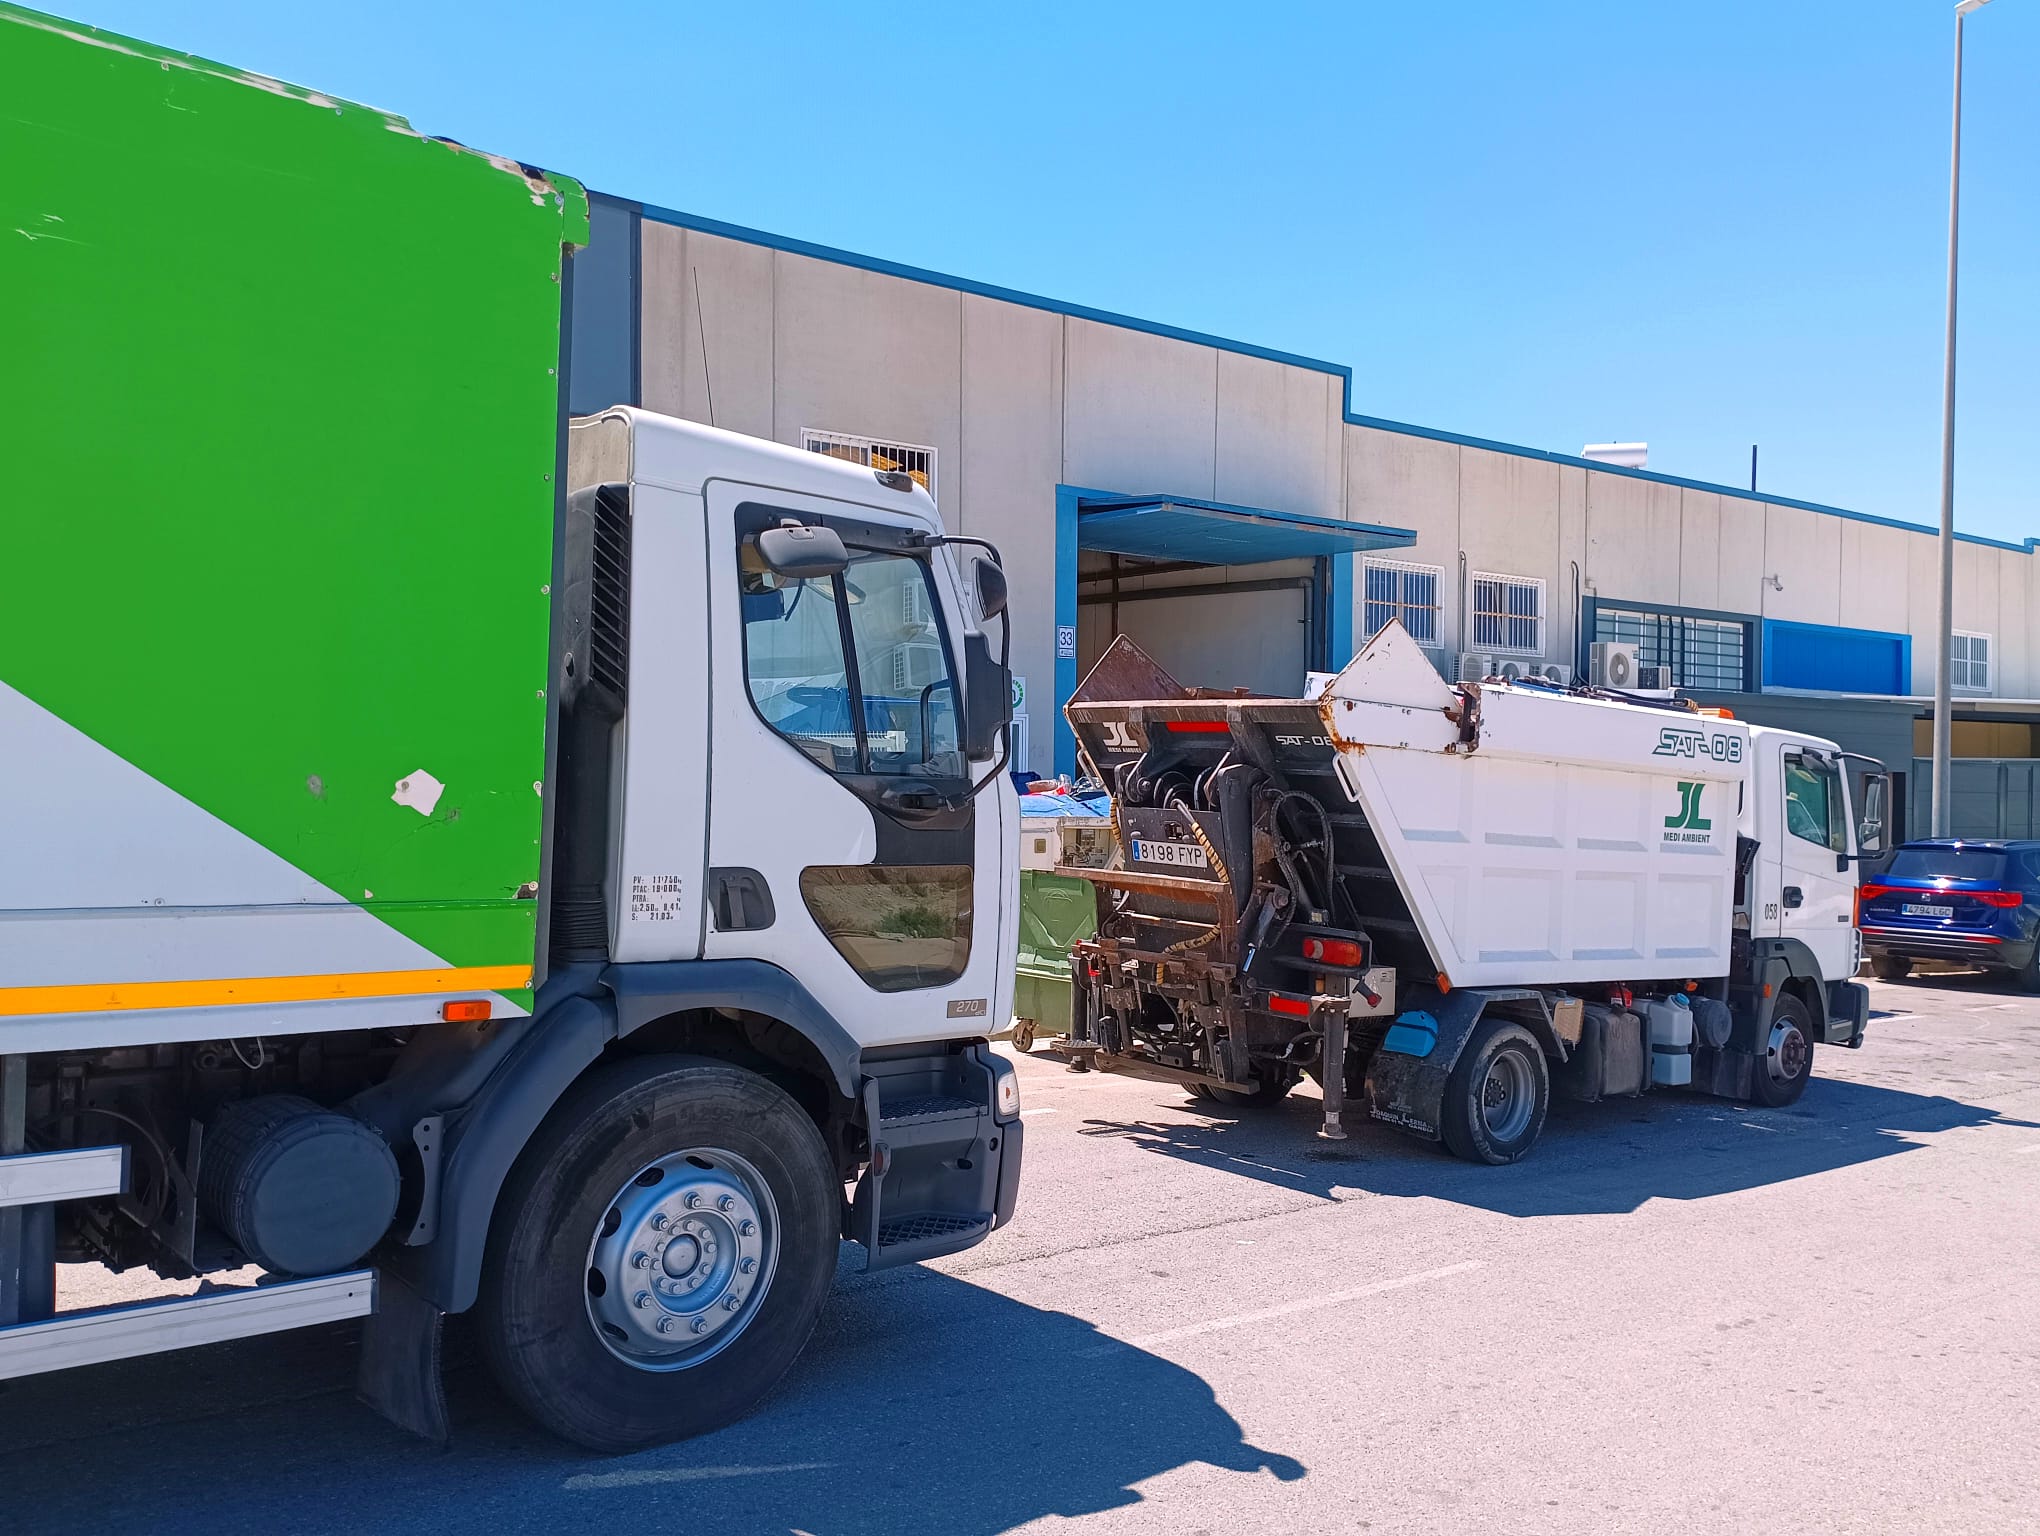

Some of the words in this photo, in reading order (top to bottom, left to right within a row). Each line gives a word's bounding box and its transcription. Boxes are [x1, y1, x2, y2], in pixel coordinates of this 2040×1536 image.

[1060, 631, 1073, 646] 33
[1652, 727, 1743, 764] SAT-08
[1663, 831, 1680, 842] MEDI
[1681, 833, 1711, 844] AMBIENT
[1141, 843, 1174, 862] 8198
[1178, 847, 1202, 865] FYP
[1764, 903, 1778, 920] 058
[1908, 905, 1930, 915] 4794
[956, 1000, 979, 1013] 270
